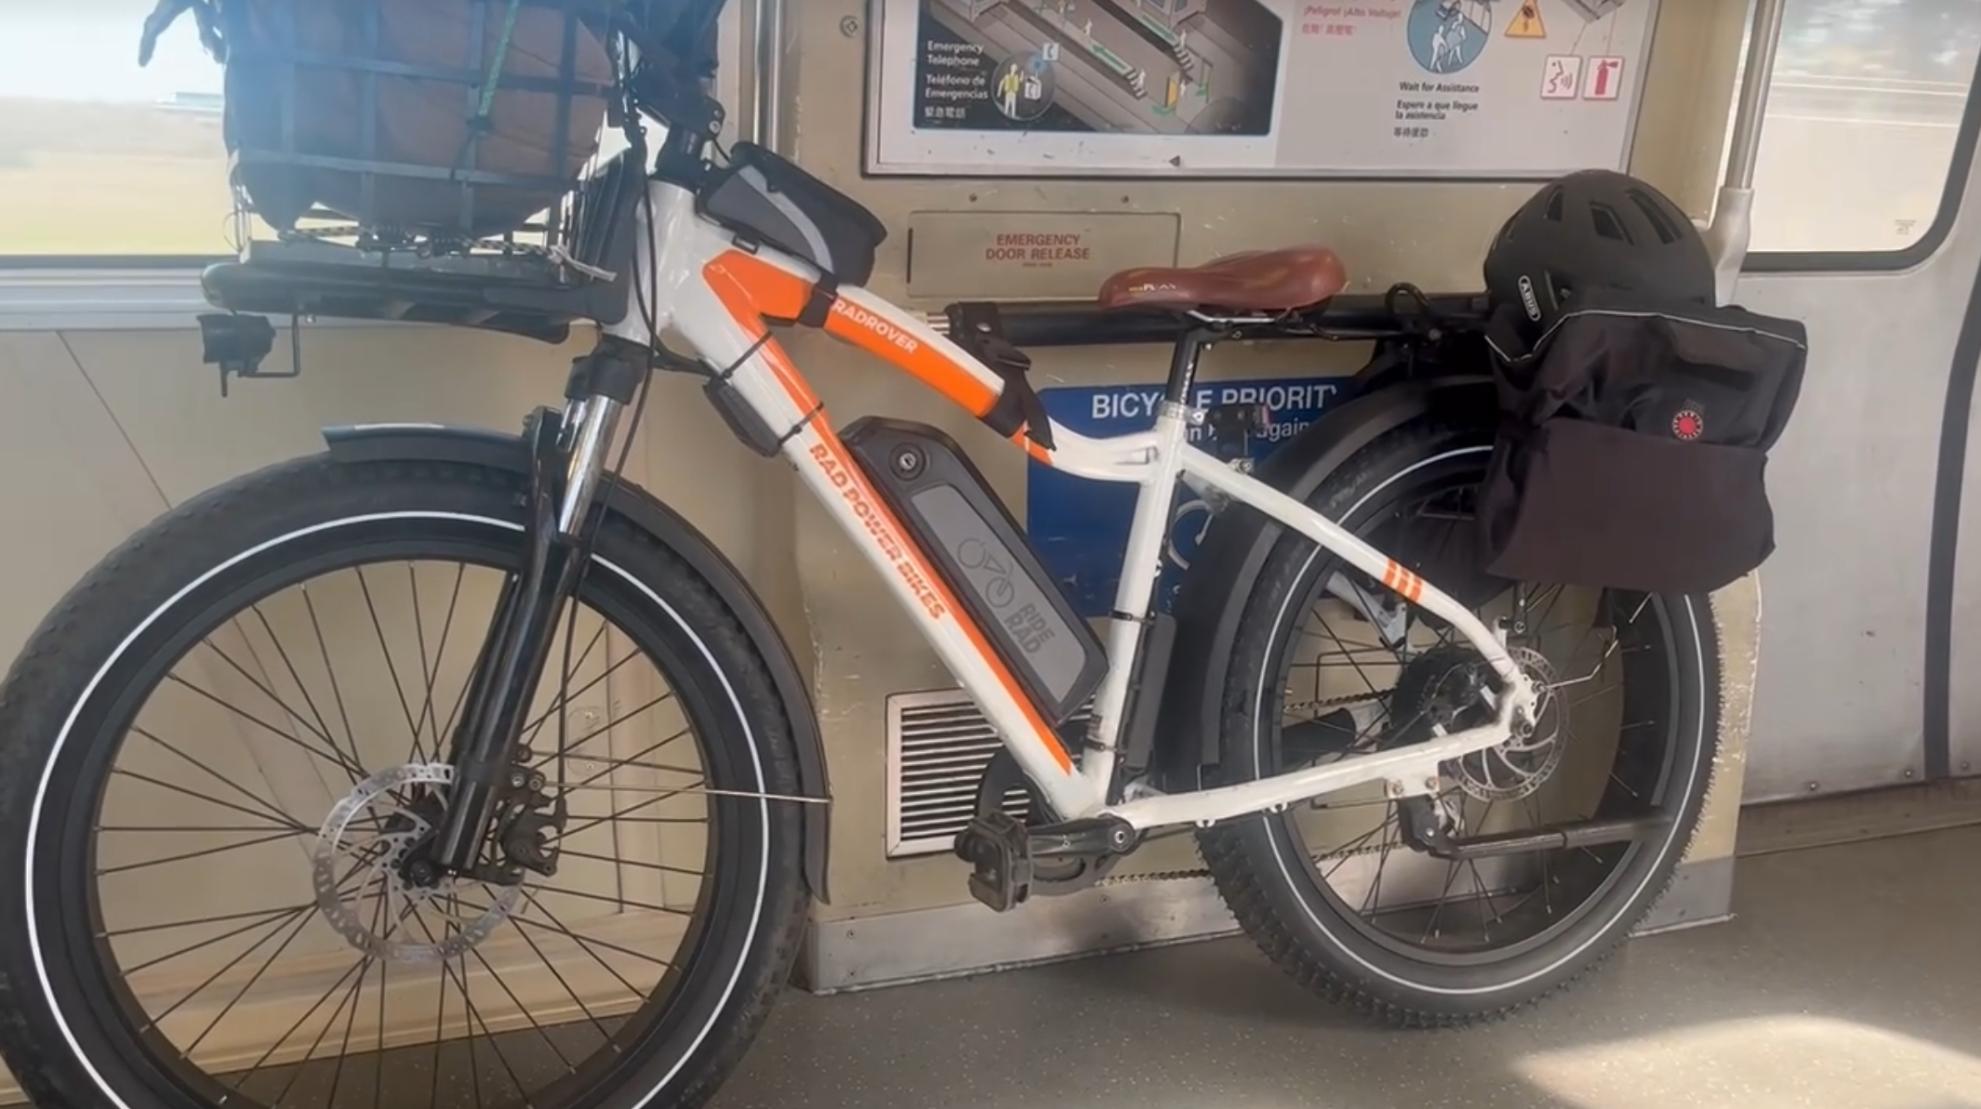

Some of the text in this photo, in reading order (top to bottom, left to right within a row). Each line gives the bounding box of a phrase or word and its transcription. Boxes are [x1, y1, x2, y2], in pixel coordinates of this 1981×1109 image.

[927, 40, 983, 54] Emergency
[927, 54, 980, 67] Telephone
[926, 73, 986, 85] Teléfono de
[1399, 81, 1480, 92] Wait for Assistance
[925, 88, 989, 101] Emergencias
[1434, 102, 1450, 112] que
[1453, 101, 1478, 112] llegue
[1395, 110, 1403, 119] la
[996, 233, 1080, 246] EMERGENCY
[985, 247, 1090, 260] DOOR RELEASE
[832, 298, 919, 353] RADROVER
[1222, 384, 1337, 412] PRIORIT
[810, 443, 946, 620] RAD POWER BIKES
[1019, 602, 1056, 642] RIDE
[1004, 612, 1042, 653] RAD
